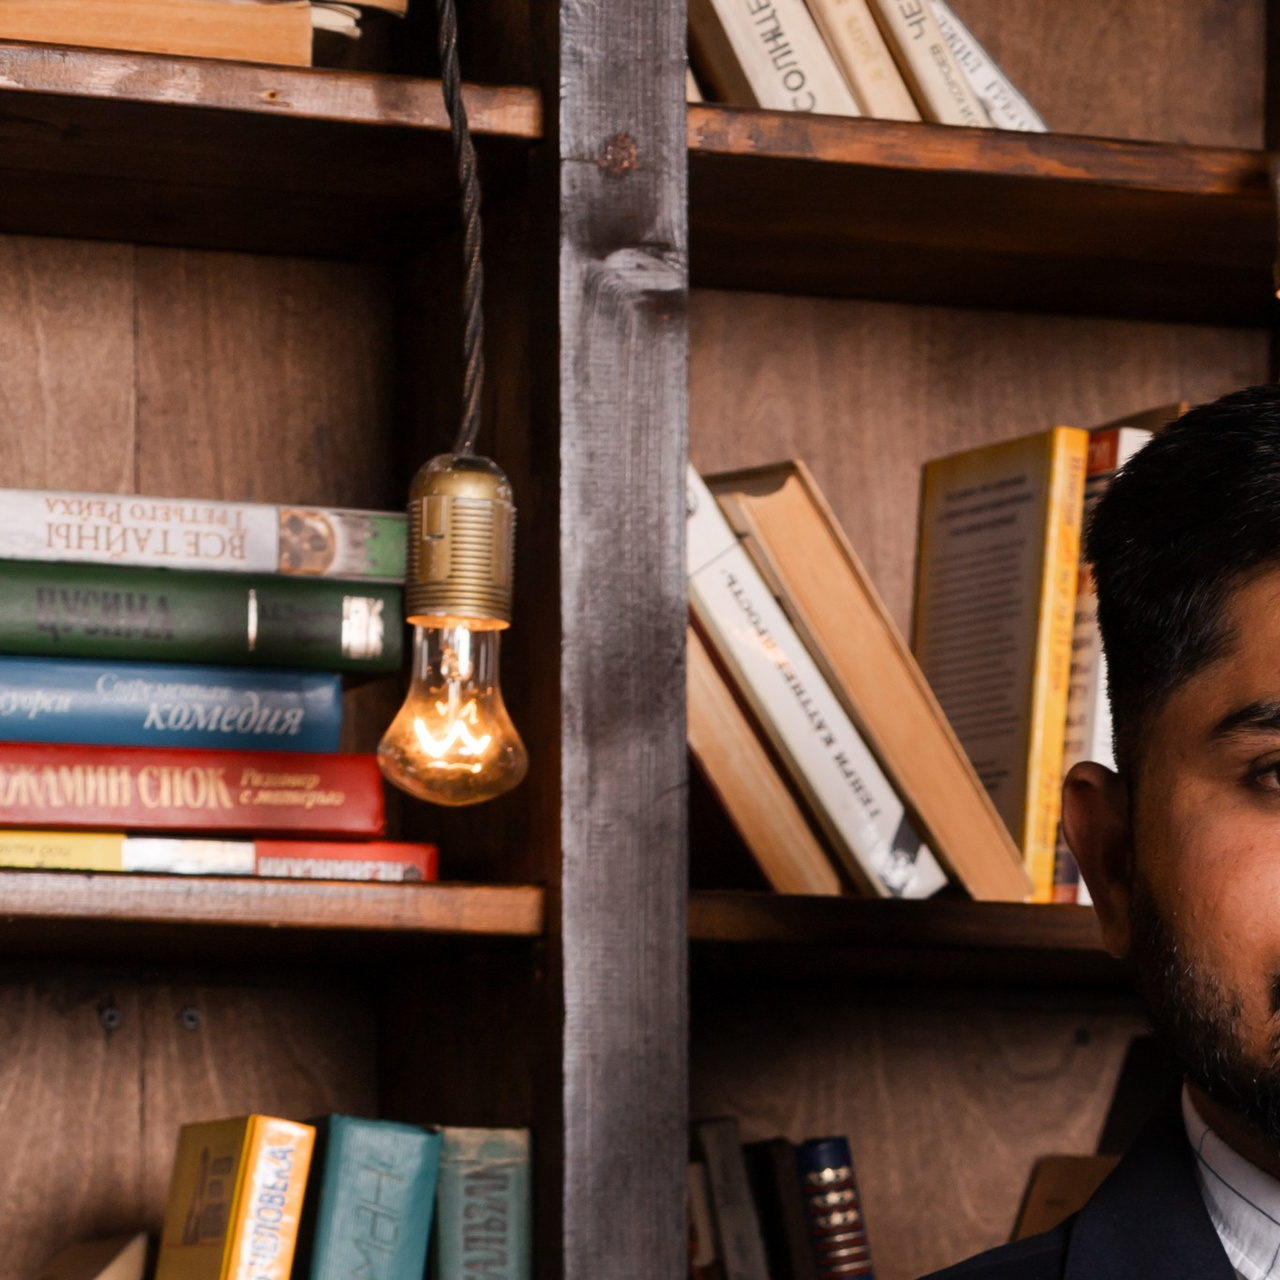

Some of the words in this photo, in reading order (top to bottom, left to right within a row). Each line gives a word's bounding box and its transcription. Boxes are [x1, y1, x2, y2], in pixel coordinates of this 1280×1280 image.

[43, 521, 177, 562] ТАЙНЫ
[181, 528, 247, 561] ВСЕ
[143, 686, 306, 736] комедия
[136, 764, 234, 811] СПОК
